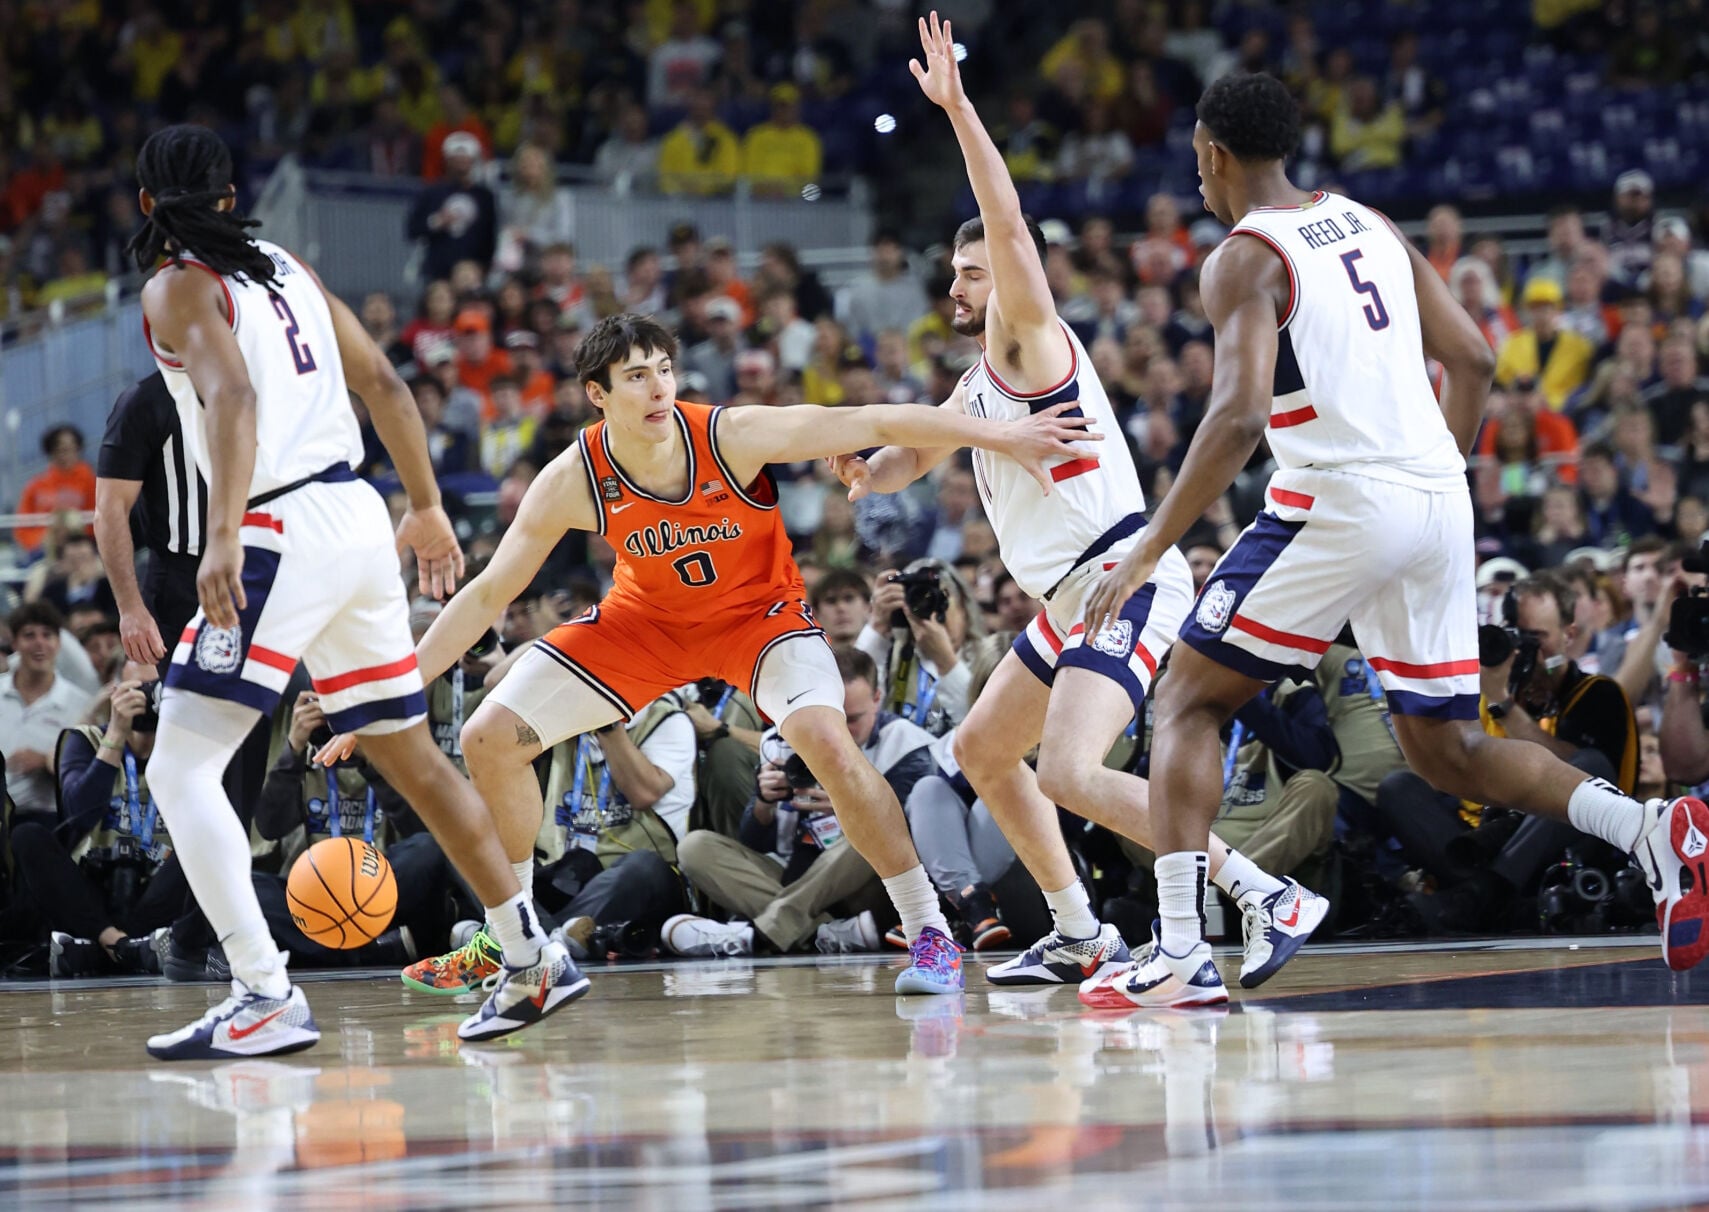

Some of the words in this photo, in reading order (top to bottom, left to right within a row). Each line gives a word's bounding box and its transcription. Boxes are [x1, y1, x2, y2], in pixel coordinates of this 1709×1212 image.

[1297, 218, 1346, 249] REED
[1341, 212, 1372, 235] JR.
[1339, 248, 1390, 331] 5
[268, 291, 317, 375] 2
[624, 517, 744, 559] Illinois
[671, 550, 719, 588] 0
